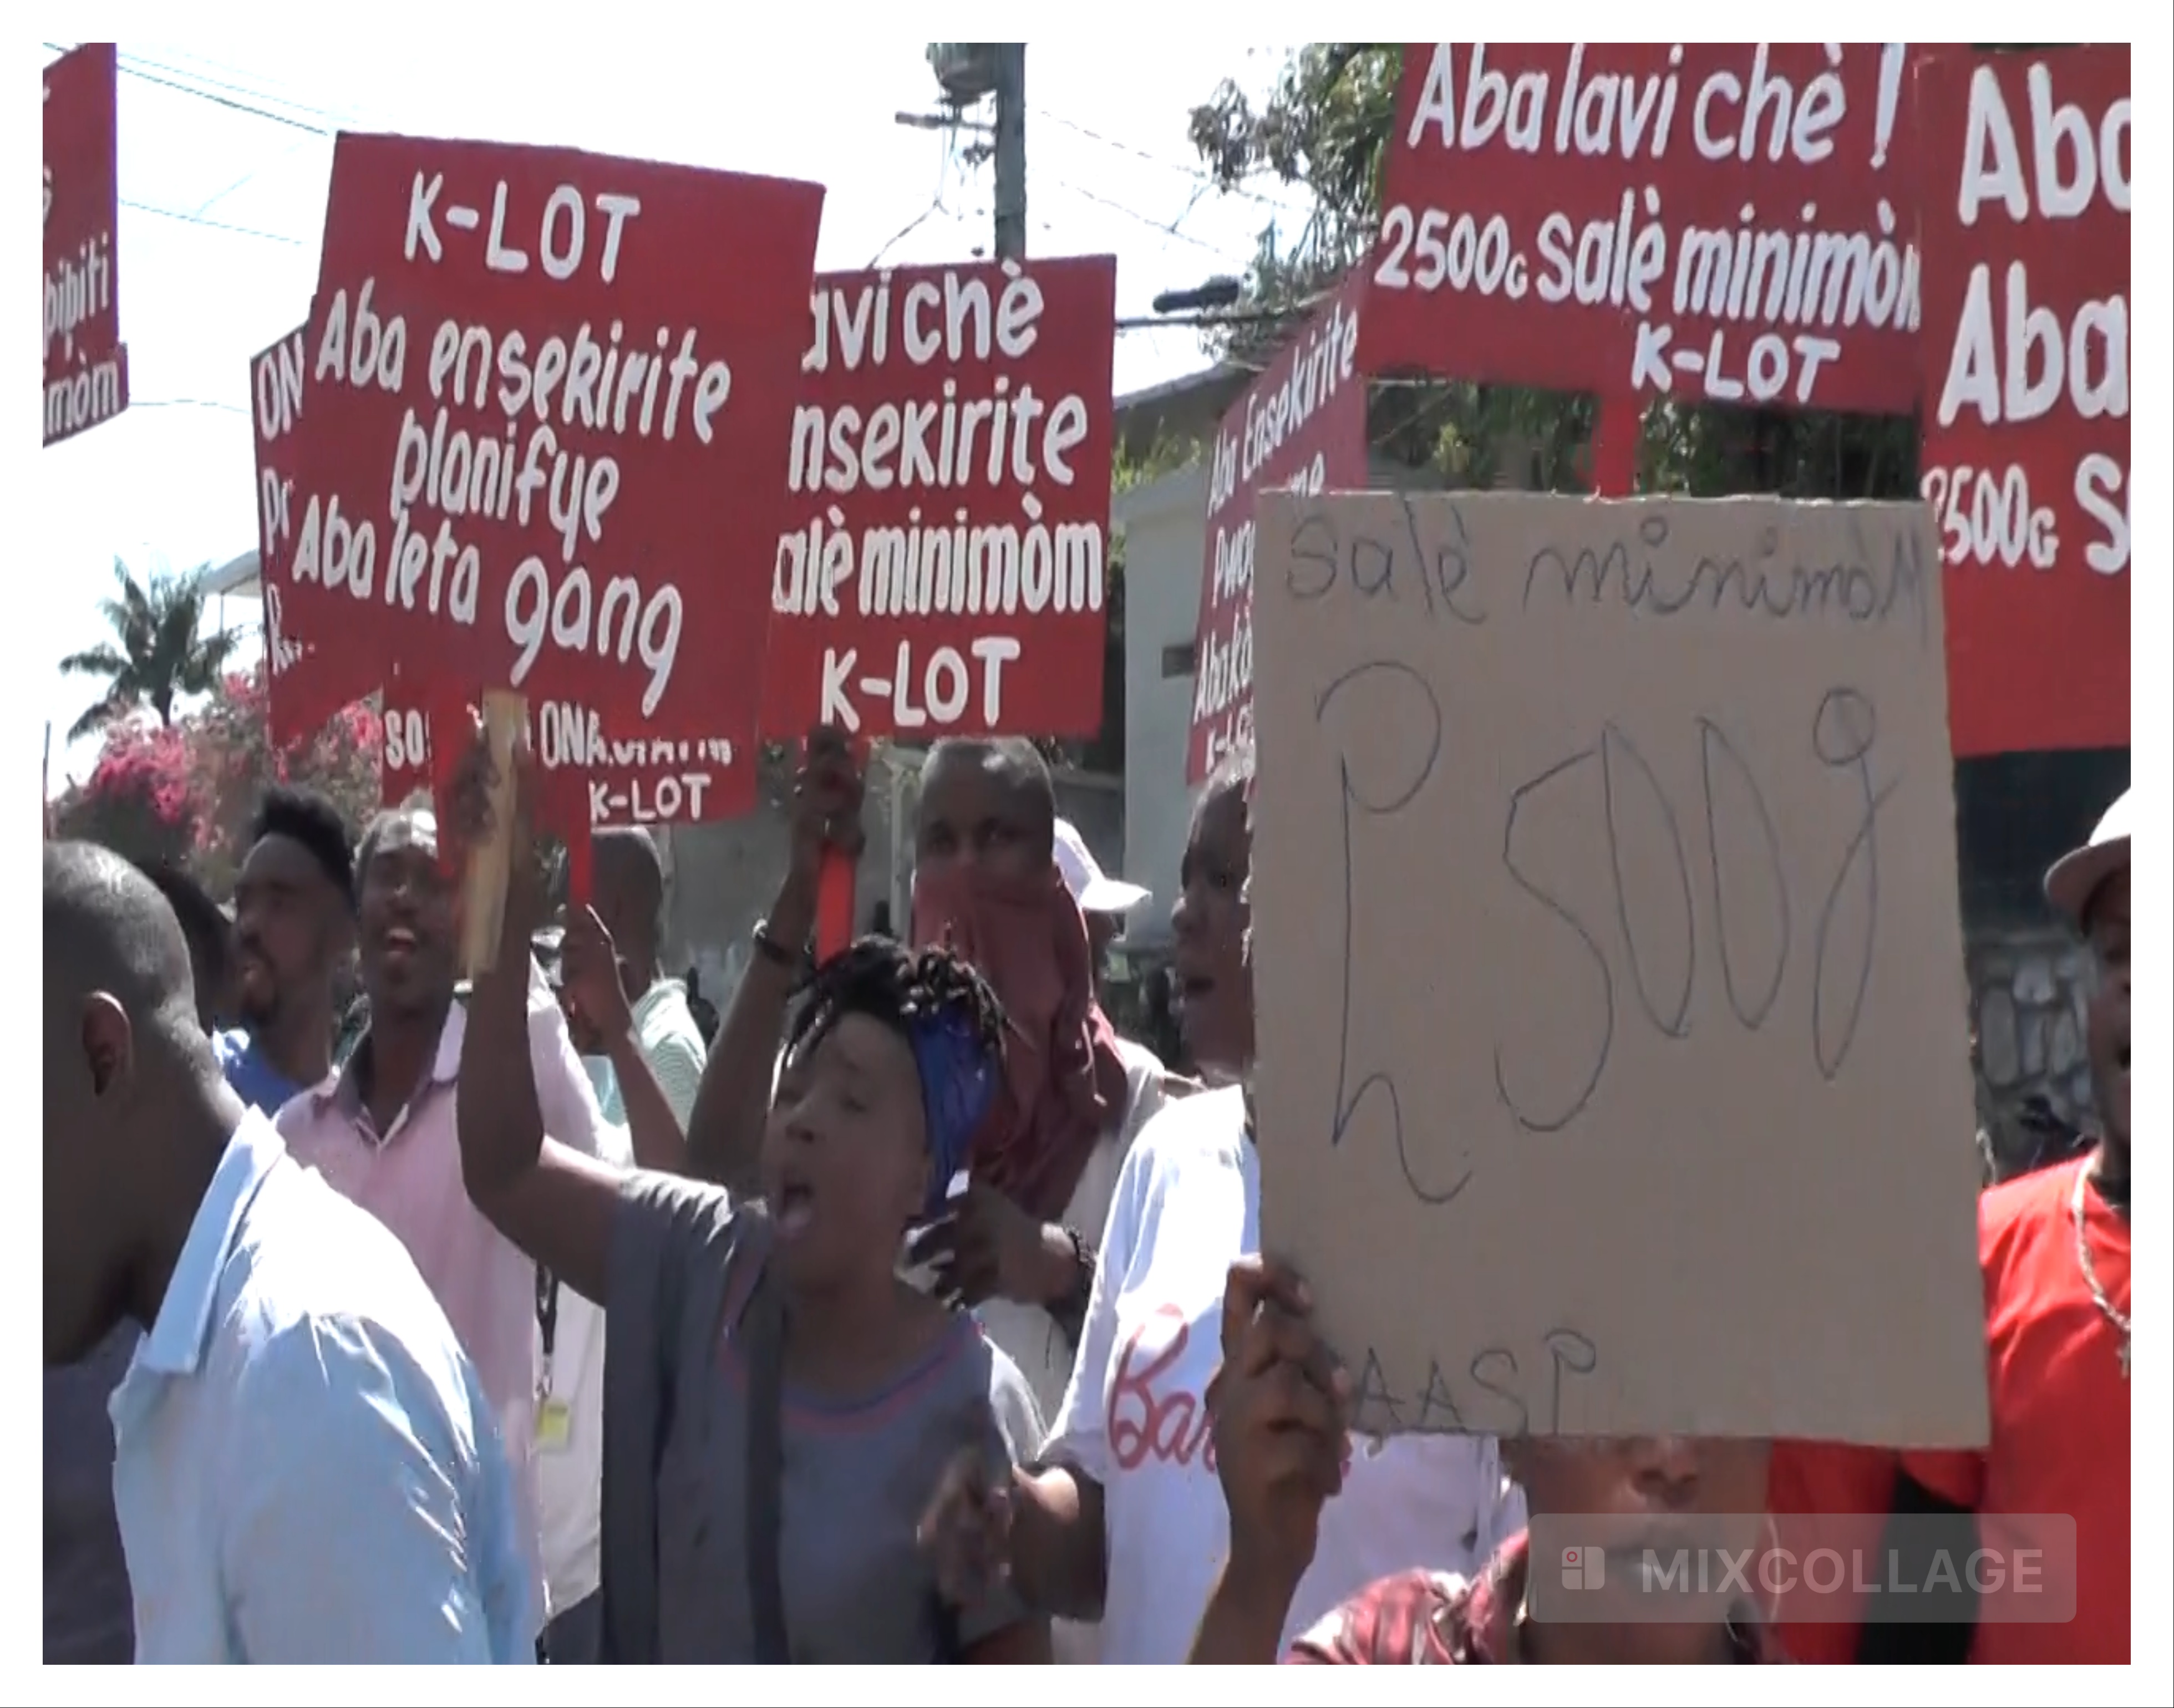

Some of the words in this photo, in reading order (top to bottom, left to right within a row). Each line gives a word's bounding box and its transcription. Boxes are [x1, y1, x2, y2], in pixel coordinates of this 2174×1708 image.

[1407, 43, 1550, 152] Aba
[1555, 43, 1684, 159] lavi
[1693, 43, 1846, 163] chè
[404, 171, 641, 283] K-LOT
[314, 276, 407, 392] Aba
[429, 319, 732, 445] ensekirite
[801, 270, 891, 372] avi
[903, 258, 1045, 364] chè
[1631, 318, 1841, 403] K-LOT
[1937, 260, 2131, 426] Aba
[256, 332, 305, 440] ON
[788, 375, 1088, 495] nsekirite
[390, 409, 621, 562] planifye
[292, 494, 376, 598] Aba
[384, 506, 480, 624] leta
[505, 555, 683, 718] gang
[771, 505, 855, 616] alè
[858, 491, 1103, 616] minimòm
[821, 638, 1021, 733] K-LOT
[588, 773, 712, 824] K-LOT
[1108, 1302, 1217, 1475] Ba
